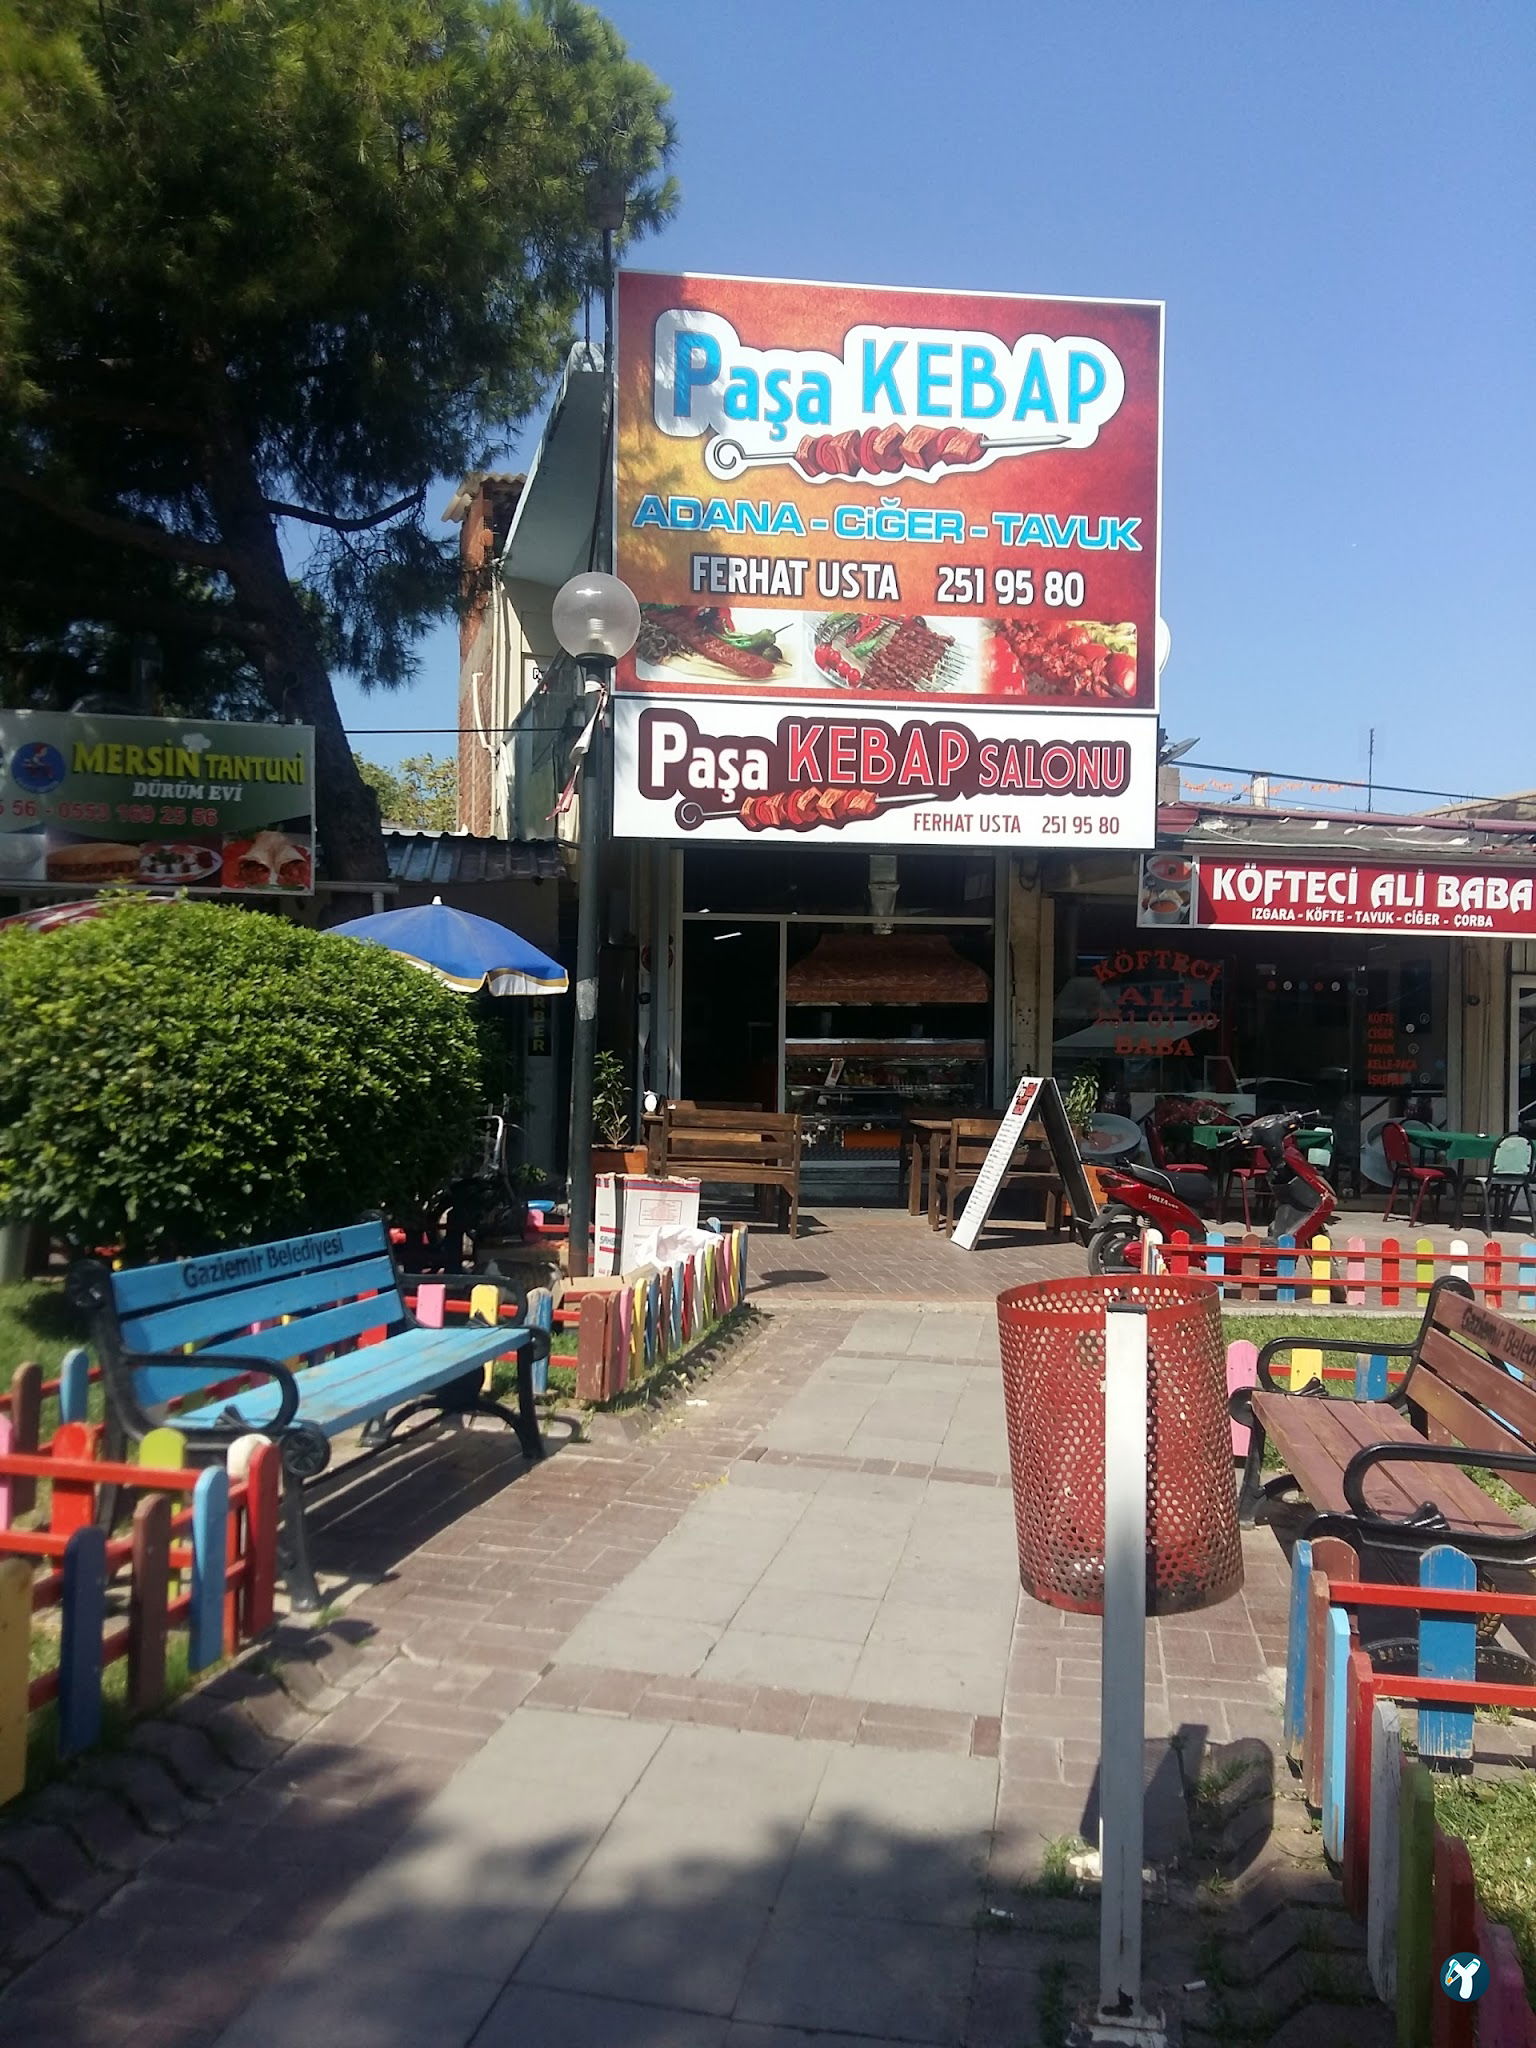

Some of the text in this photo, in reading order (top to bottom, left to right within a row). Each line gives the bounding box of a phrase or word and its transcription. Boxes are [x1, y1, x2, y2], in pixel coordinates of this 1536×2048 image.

[673, 330, 1107, 442] Paşa KEBAP
[632, 494, 807, 537] ADANA
[992, 511, 1143, 552] TAVUK
[692, 555, 1085, 608] FERHAT USTA 251 95 80
[73, 738, 305, 785] MERSİN TANTUNİ
[651, 720, 1125, 804] Paşa KEBAP SALONU
[132, 779, 244, 801] DÜRÜM EVİ
[159, 805, 187, 825] 25
[913, 812, 1120, 835] FERHAT USTA 251 95 80
[1212, 862, 1534, 914] KÖFTECİ ALİ BABA
[1251, 907, 1296, 921] IZGARA
[1305, 906, 1345, 922] KÖFTE
[1355, 911, 1395, 924] TAVUK
[1404, 909, 1440, 926] CİĞER
[1453, 913, 1494, 928] ÇORBA
[1114, 1036, 1196, 1056] BABA
[183, 1232, 345, 1289] Gaziemir Belediyesi
